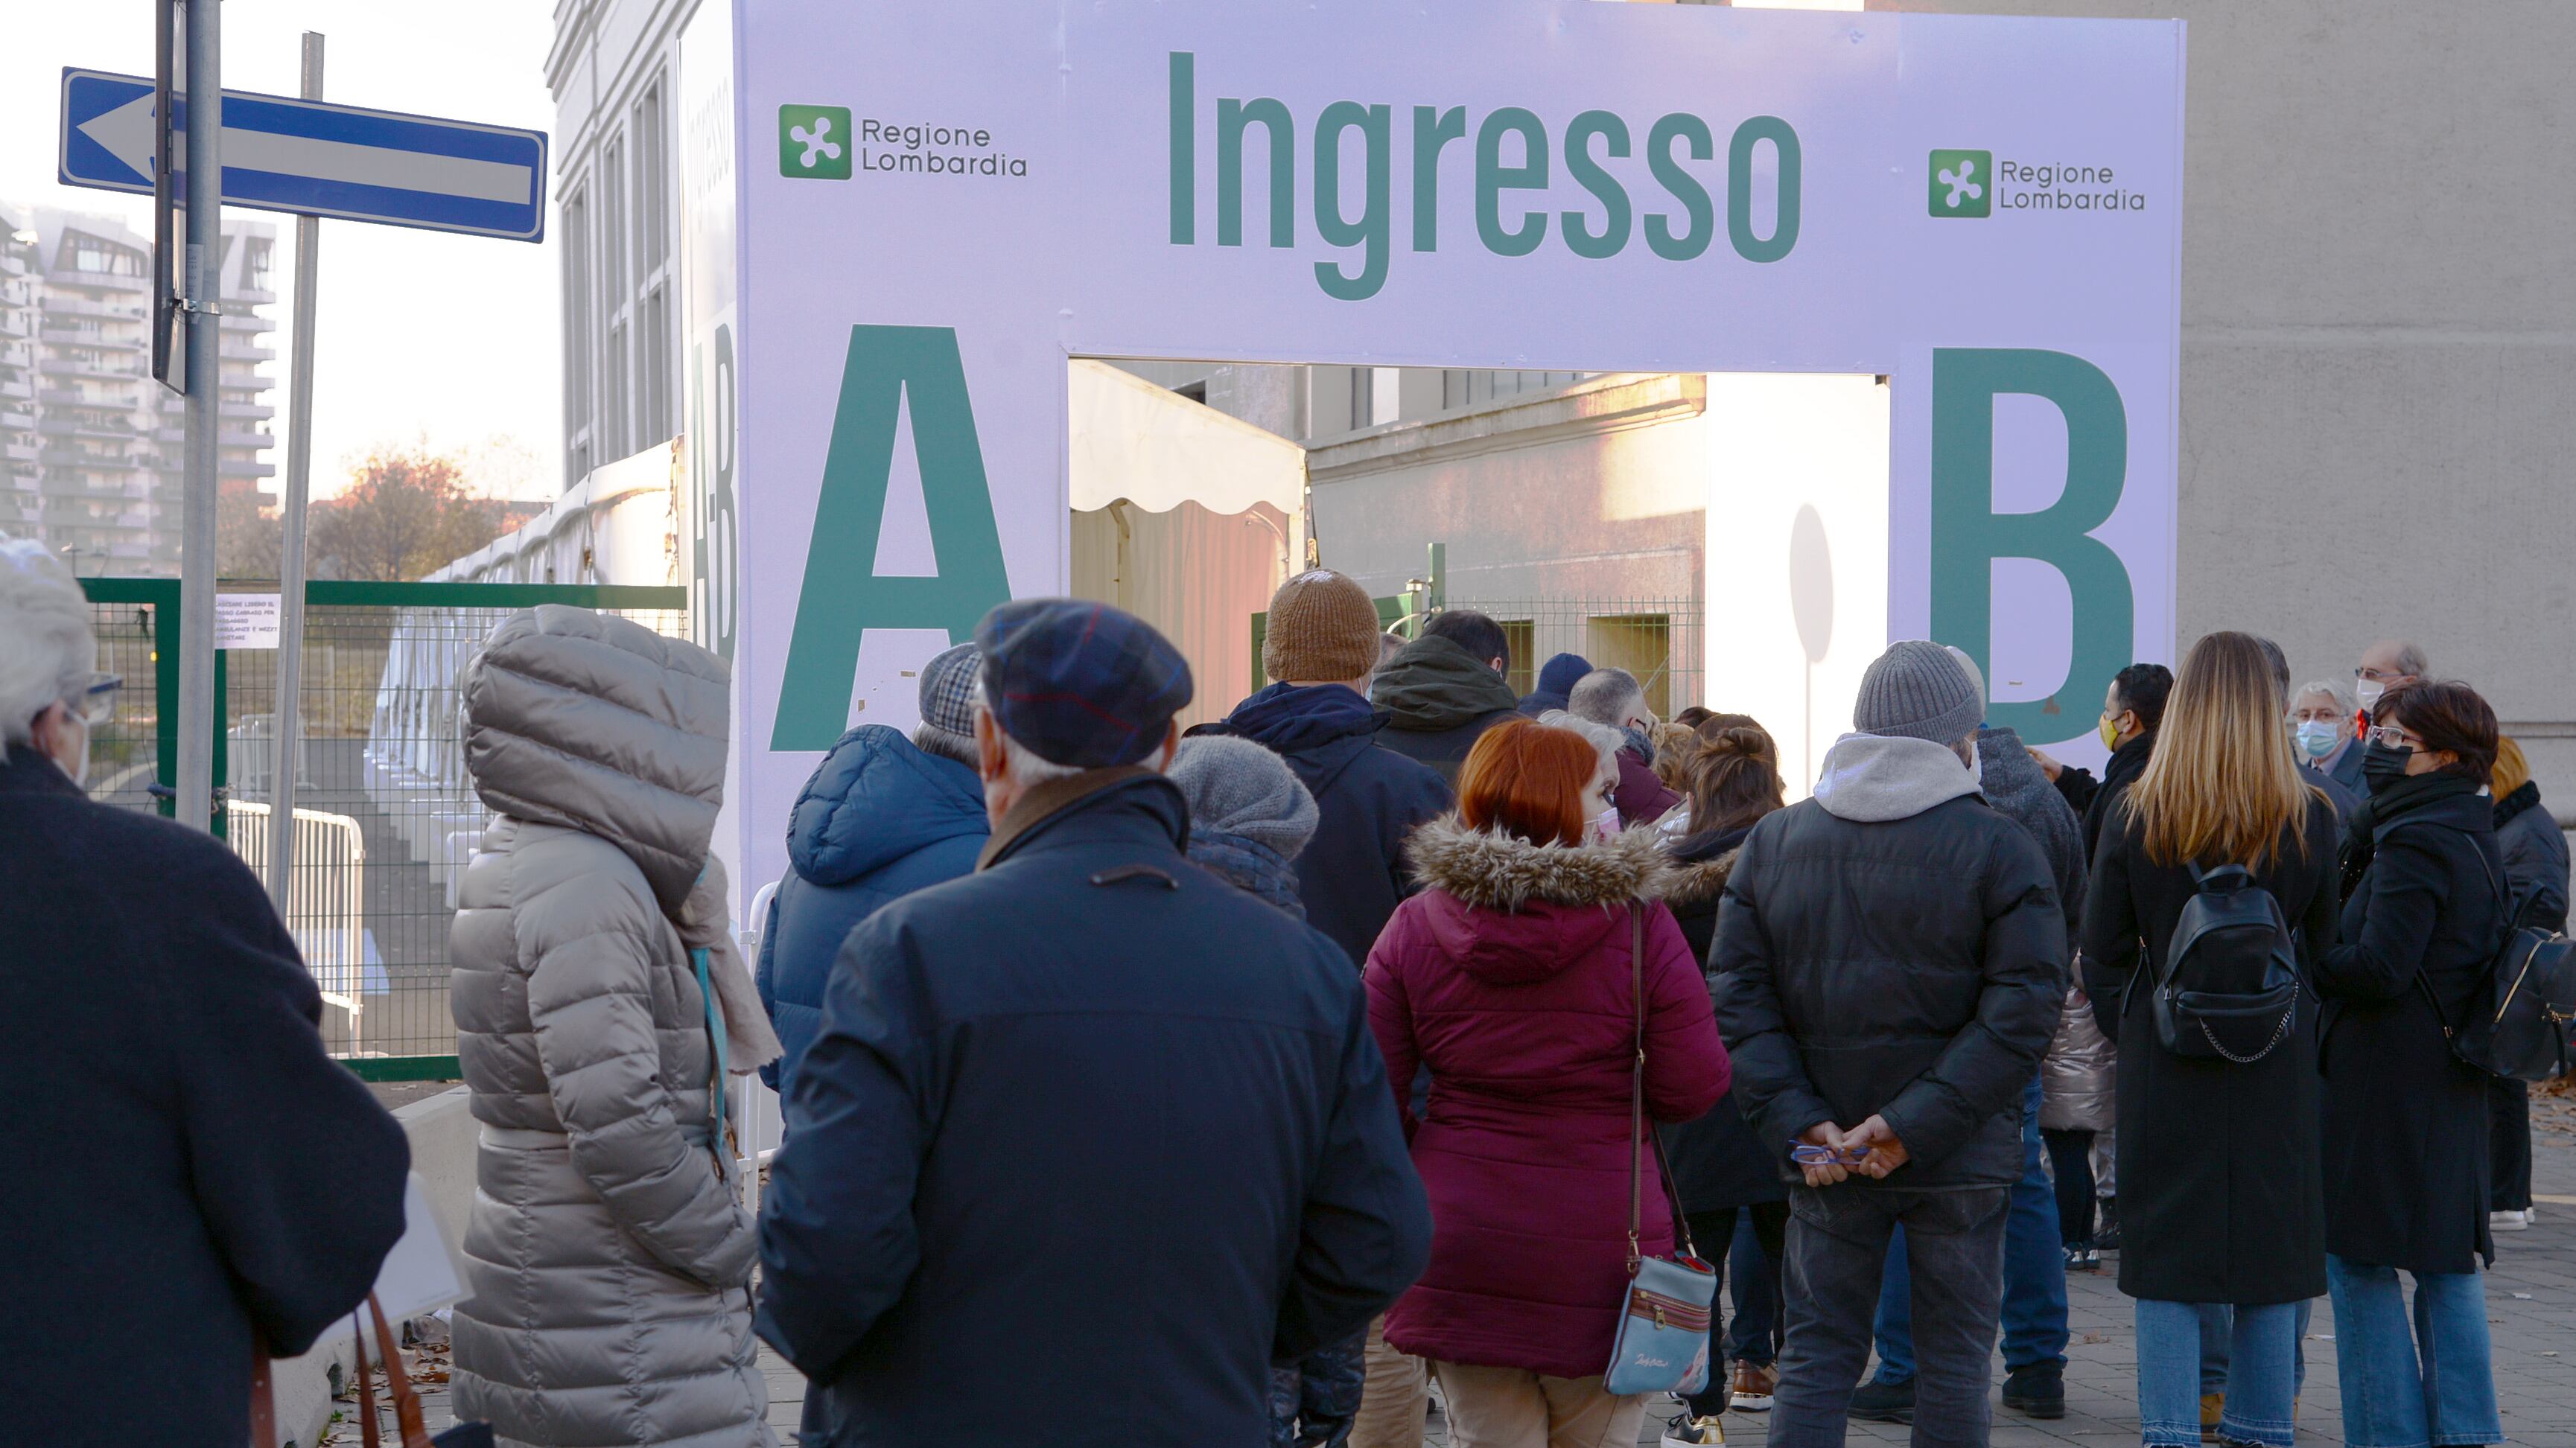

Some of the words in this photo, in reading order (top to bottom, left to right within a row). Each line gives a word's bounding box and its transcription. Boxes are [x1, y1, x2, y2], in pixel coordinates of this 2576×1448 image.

[687, 76, 731, 233] Ingresso
[862, 119, 990, 150] Regione
[862, 147, 1027, 177] Lombardia
[1170, 51, 1801, 302] Ingresso
[2001, 161, 2114, 188] Regione
[2000, 187, 2146, 211] Lombardia
[770, 325, 1014, 752] A
[1930, 348, 2135, 747] B
